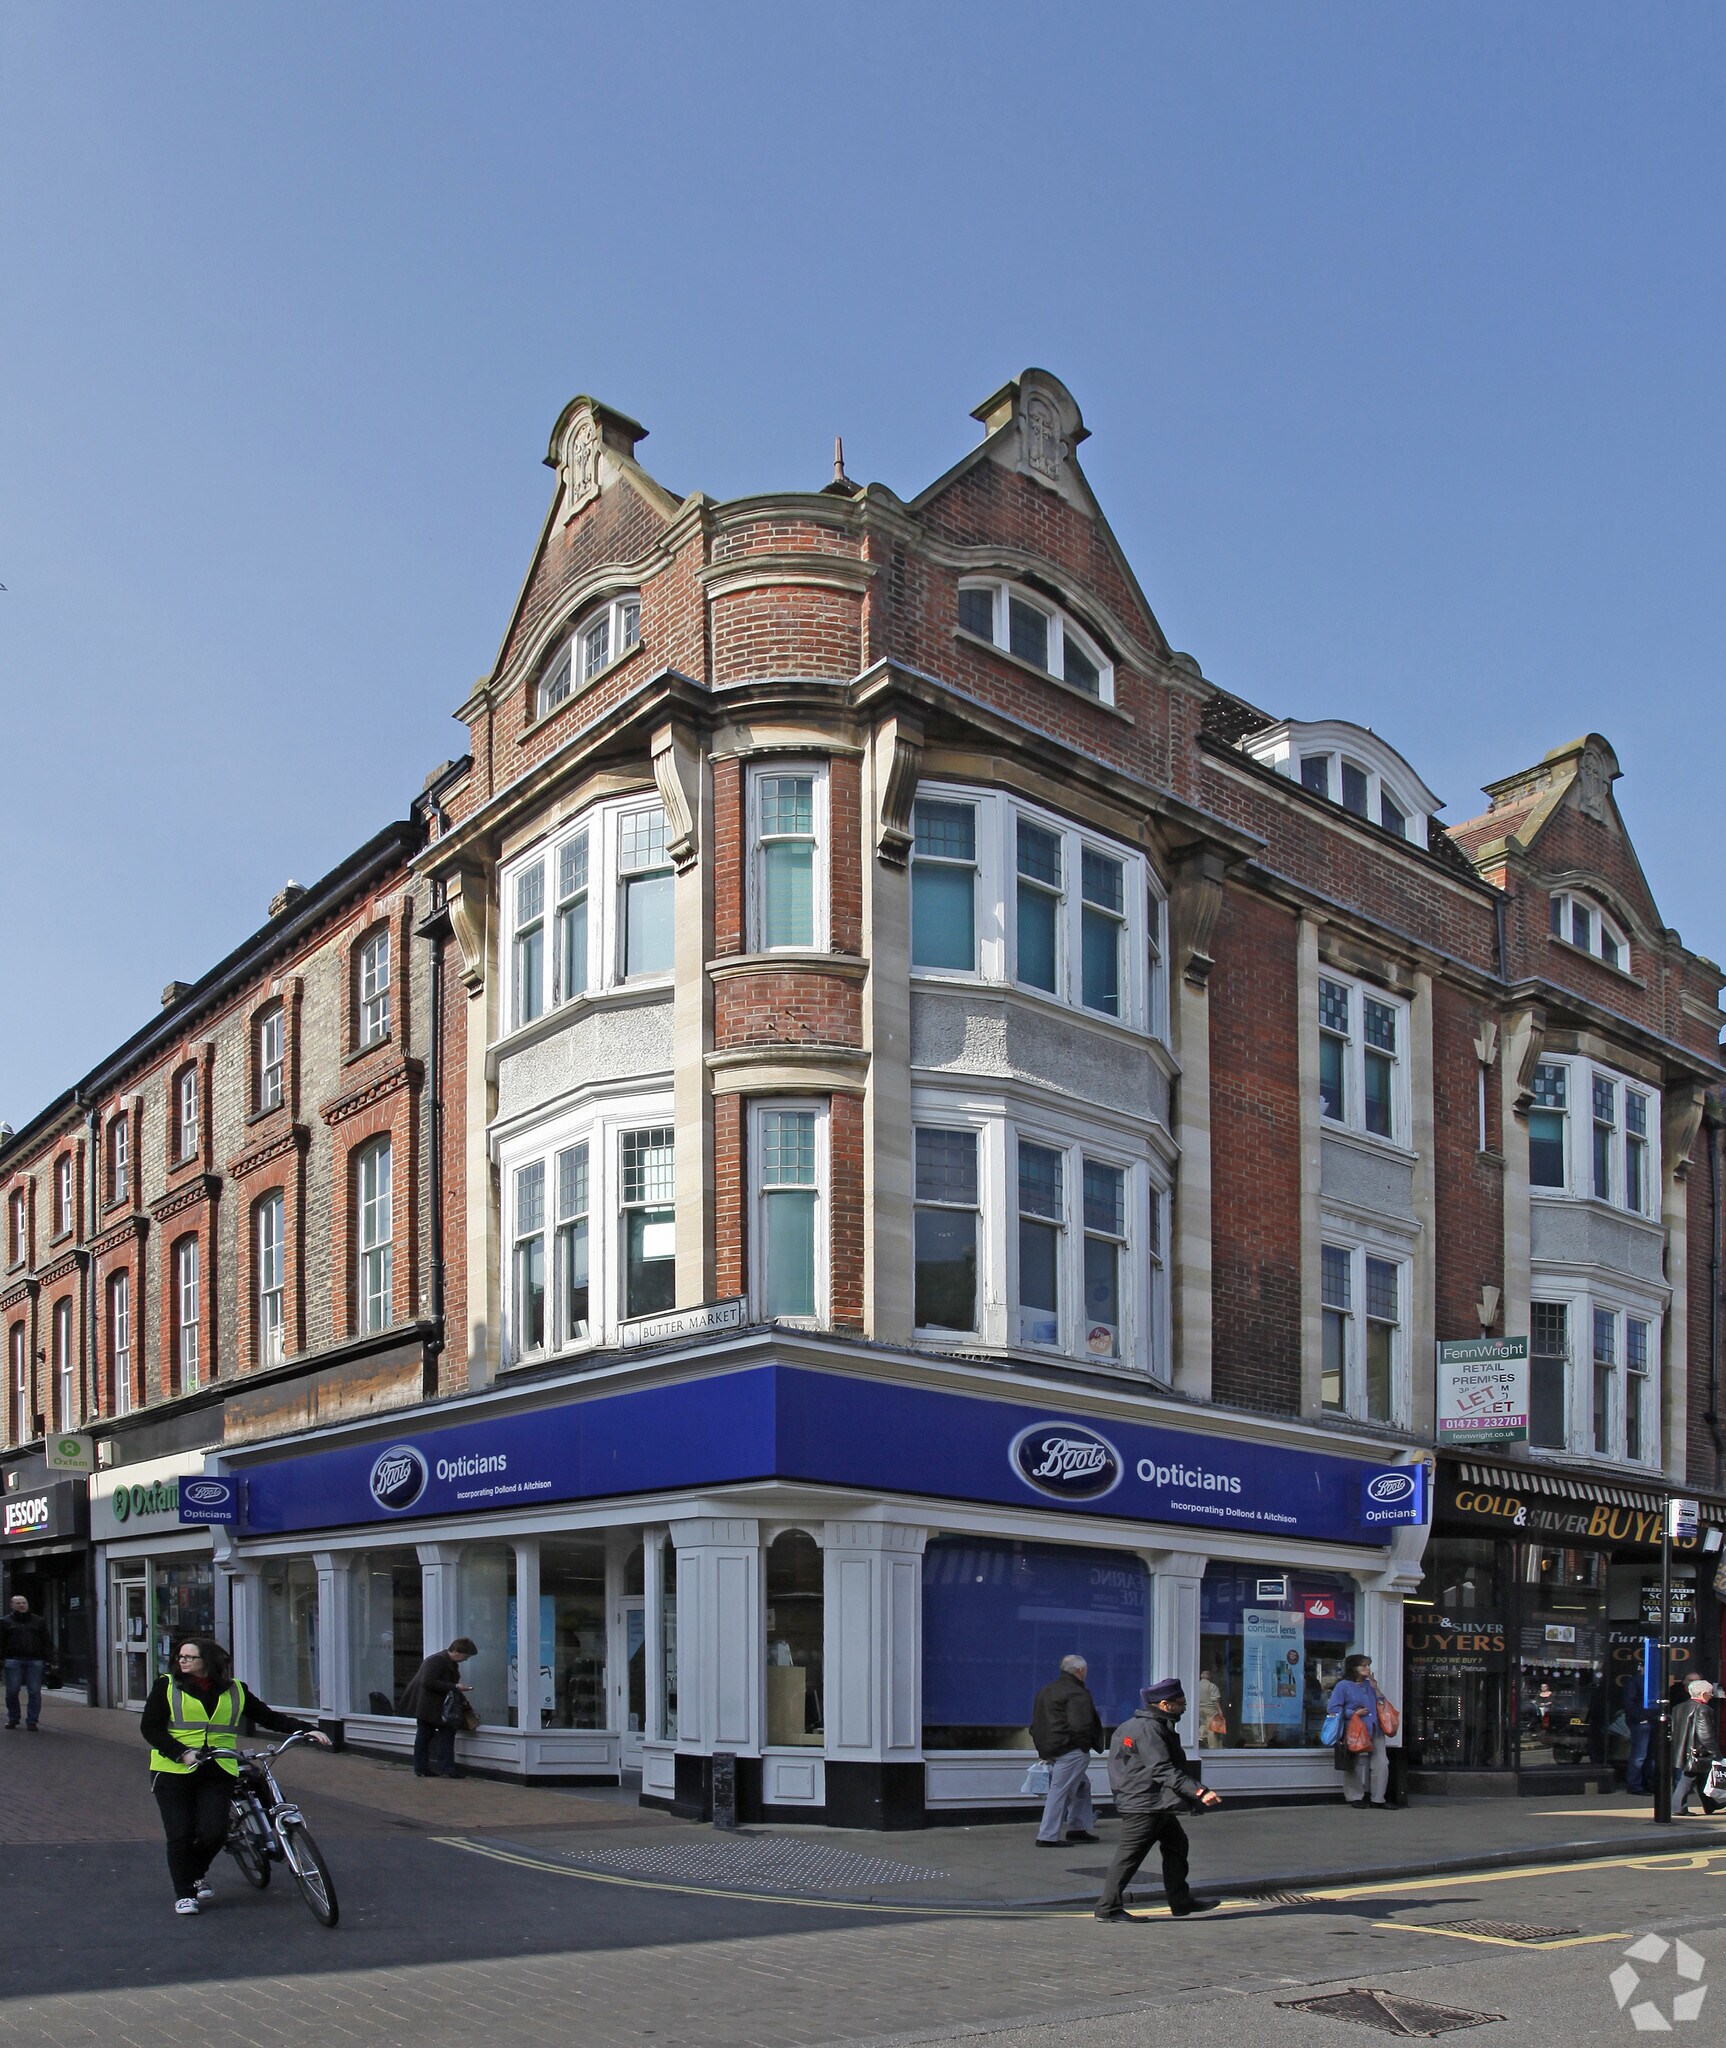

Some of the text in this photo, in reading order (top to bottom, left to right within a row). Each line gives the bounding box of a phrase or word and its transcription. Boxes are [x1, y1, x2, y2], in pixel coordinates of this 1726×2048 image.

[643, 1308, 737, 1339] BUTTER MARKET
[1444, 1343, 1524, 1360] FennWright
[1462, 1363, 1505, 1373] RETAIL
[1452, 1373, 1515, 1386] PREMISES
[1456, 1385, 1495, 1412] LET
[1446, 1416, 1522, 1429] 01473 232701
[1452, 1430, 1515, 1440] fennwright.co.uk
[53, 1457, 88, 1467] Oxfam
[436, 1453, 507, 1482] Opticians
[1032, 1437, 1108, 1480] Boots
[375, 1458, 412, 1496] Boots
[1136, 1458, 1242, 1494] Opticians
[457, 1487, 494, 1500] incorporating
[523, 1480, 552, 1491] Aitchison
[1374, 1479, 1406, 1497] Boots
[130, 1480, 178, 1516] Oxfam
[4, 1496, 48, 1535] JESSOPS
[184, 1509, 232, 1519] Opticians
[1171, 1500, 1224, 1517] incorporating
[1226, 1507, 1255, 1519] Dollond
[1263, 1512, 1297, 1524] Aitchison
[1366, 1509, 1417, 1521] Opticians
[1455, 1491, 1521, 1517] GOLD
[1513, 1506, 1527, 1526] &
[1528, 1509, 1589, 1535] SILVER
[1649, 1592, 1687, 1600] SCAP
[1642, 1605, 1691, 1613] WATED
[1279, 1625, 1296, 1635] lens
[1440, 1617, 1453, 1628] &
[1452, 1623, 1504, 1633] SILVER
[1405, 1634, 1505, 1652] UYERS
